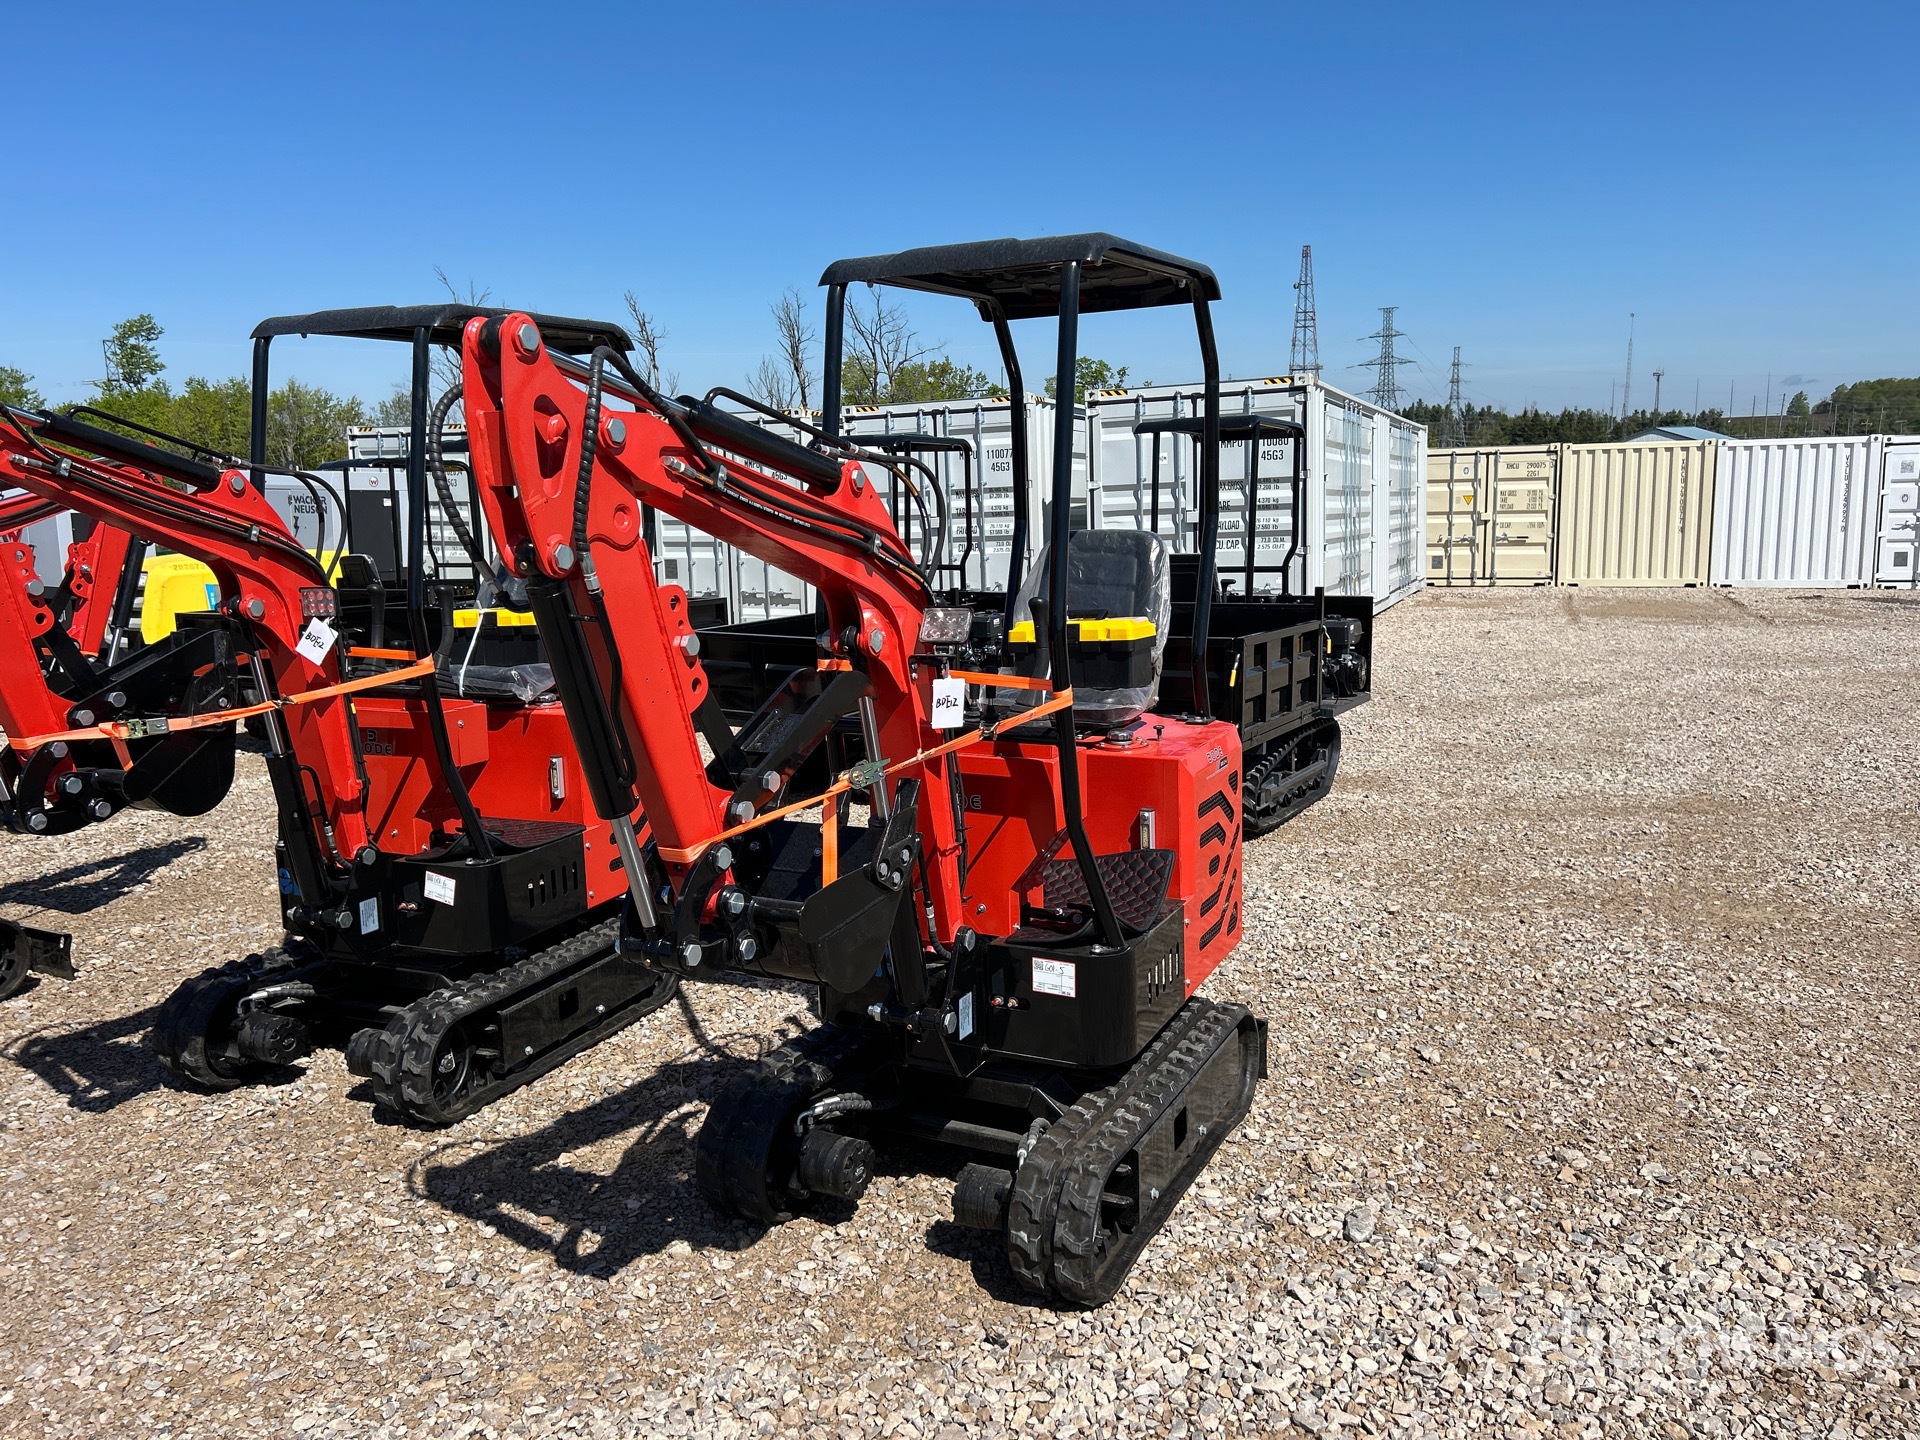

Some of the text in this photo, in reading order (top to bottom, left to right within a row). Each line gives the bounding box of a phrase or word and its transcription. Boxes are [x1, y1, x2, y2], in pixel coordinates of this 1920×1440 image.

[1261, 450, 1284, 461] 45G3
[991, 462, 1010, 472] 45G3
[1526, 461, 1547, 470] 290075
[293, 495, 327, 505] WACKR
[294, 504, 327, 514] NEUSN
[1217, 520, 1240, 530] AYLOAD
[1226, 540, 1240, 550] CAP.
